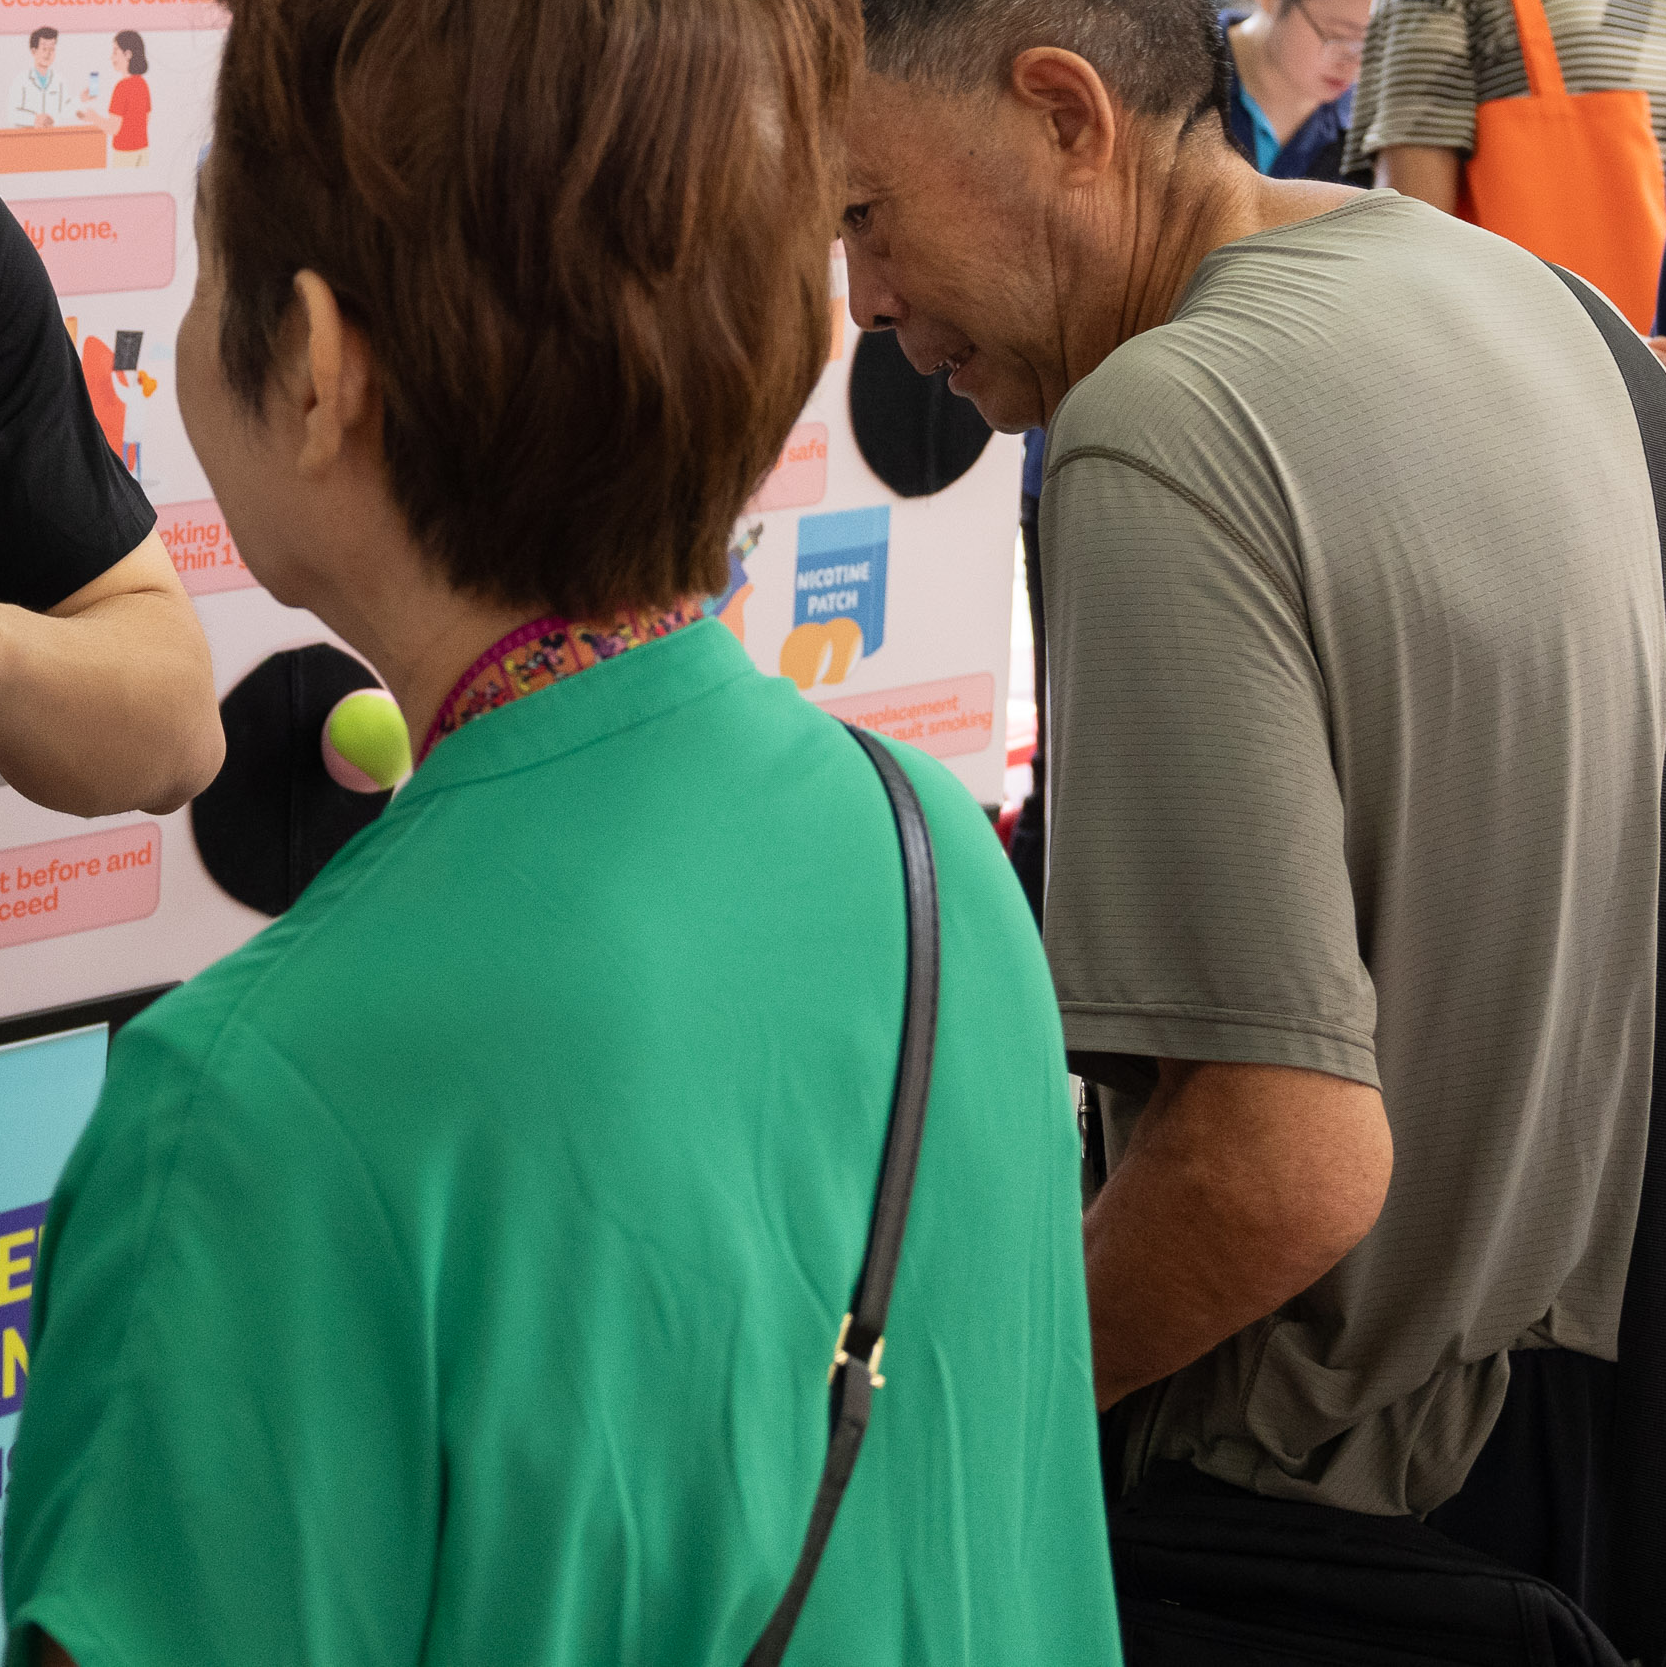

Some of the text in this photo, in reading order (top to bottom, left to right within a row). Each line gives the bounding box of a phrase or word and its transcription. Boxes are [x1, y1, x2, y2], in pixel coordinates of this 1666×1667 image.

[51, 218, 118, 242] done,
[788, 439, 827, 462] safe
[221, 544, 234, 565] 1
[798, 561, 870, 590] NICOTINE
[807, 591, 858, 615] PATCH
[16, 858, 101, 891] before
[106, 840, 152, 874] and
